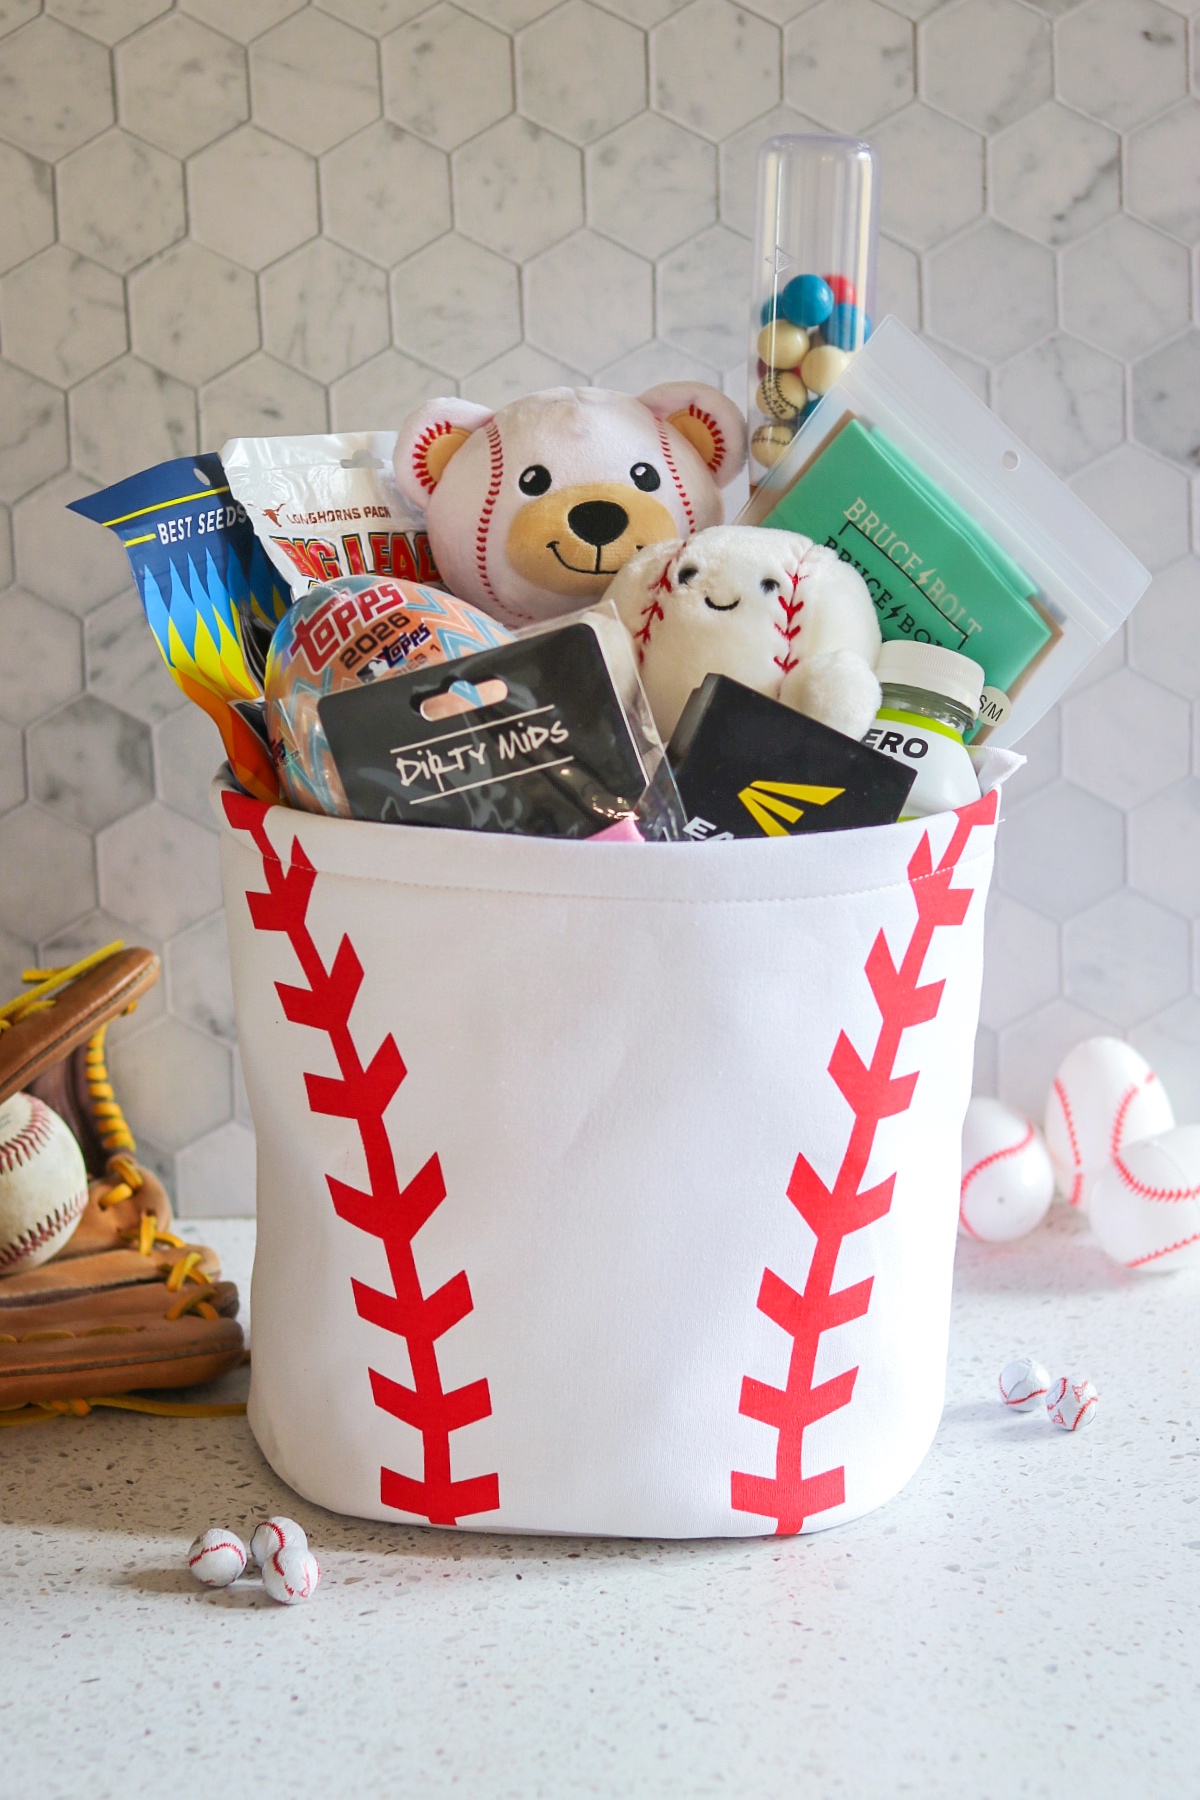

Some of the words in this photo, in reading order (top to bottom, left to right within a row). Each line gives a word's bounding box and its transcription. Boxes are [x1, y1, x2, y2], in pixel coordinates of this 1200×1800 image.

[157, 516, 193, 545] BEST
[197, 505, 247, 535] SEEDS
[286, 508, 361, 525] LONGHORNS
[363, 506, 392, 519] PACK
[843, 496, 923, 578] BRUCE
[922, 577, 983, 642] BOLT
[339, 612, 410, 669] 2026
[979, 694, 1004, 722] S/M
[860, 728, 929, 759] ERO
